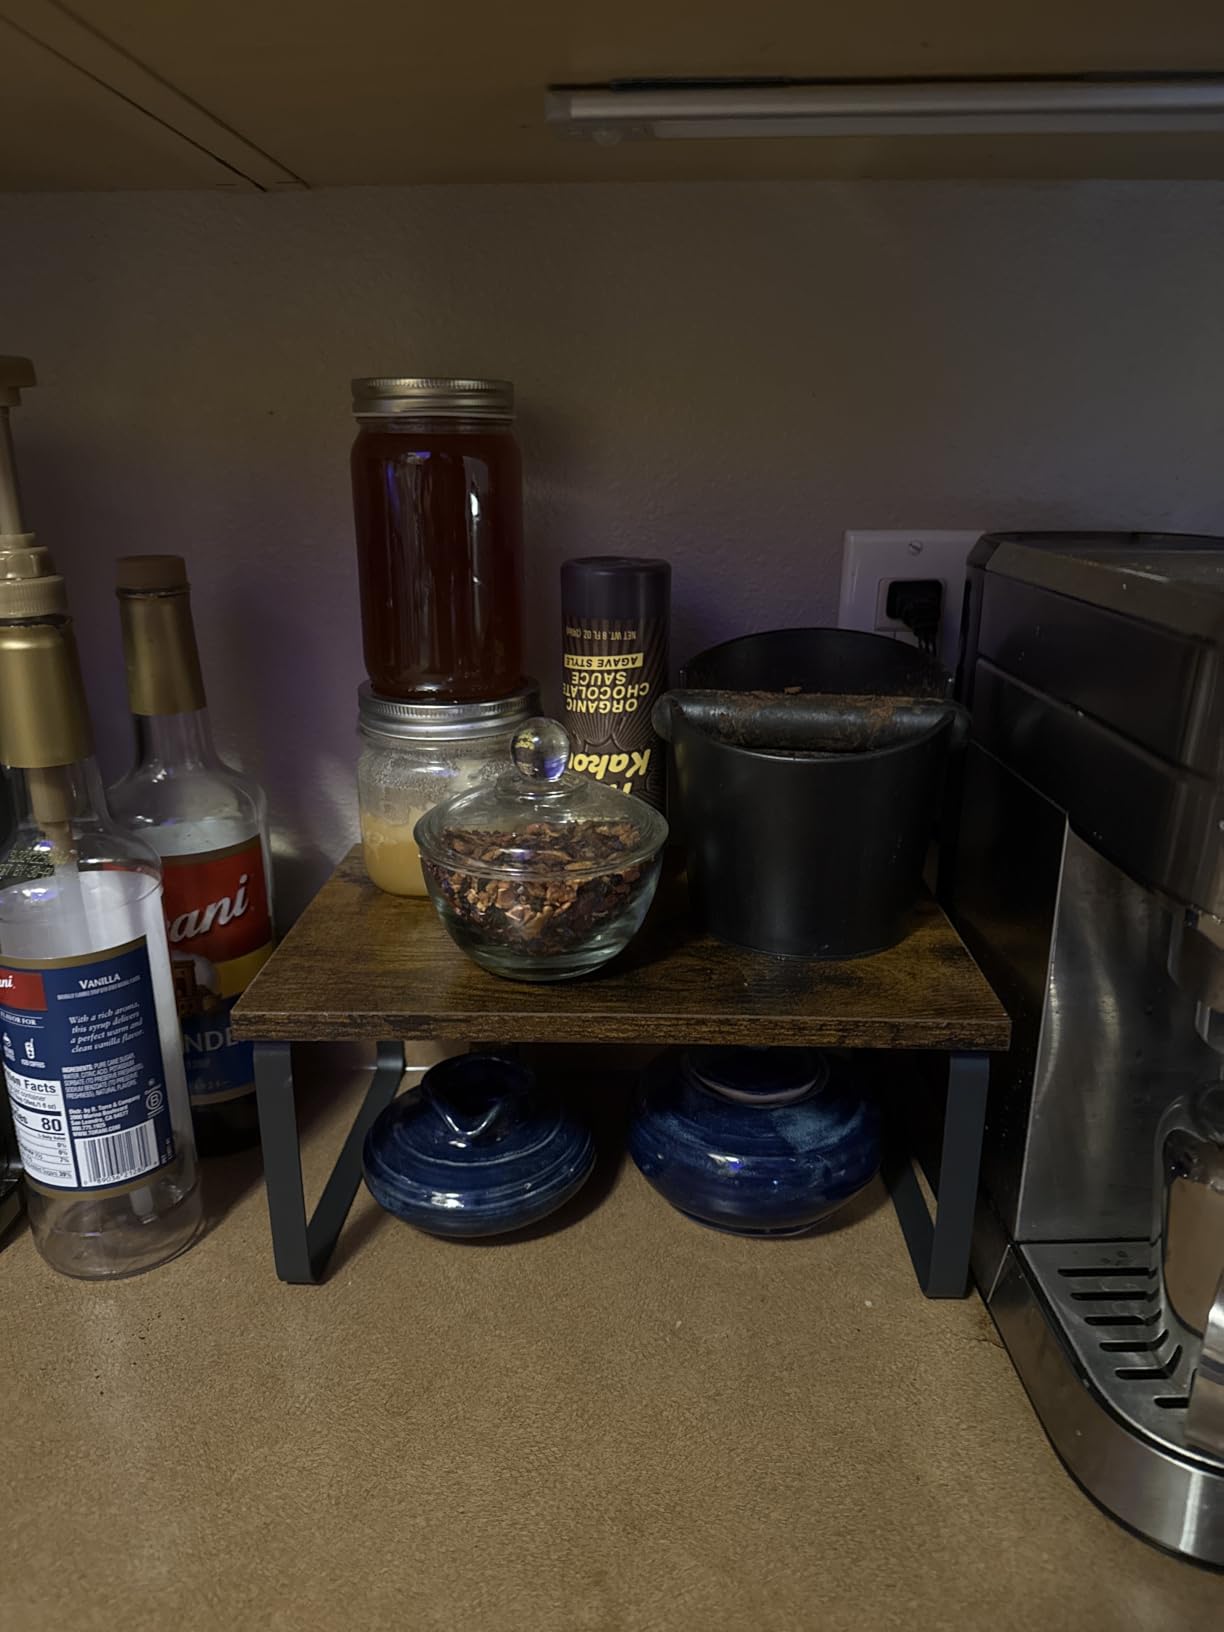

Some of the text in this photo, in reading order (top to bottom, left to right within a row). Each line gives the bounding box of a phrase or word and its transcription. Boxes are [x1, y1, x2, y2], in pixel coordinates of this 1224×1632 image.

[566, 656, 638, 668] AGAVE STYLE
[571, 671, 627, 686] SAUCE
[562, 682, 650, 699] CHOCOLATE
[566, 698, 638, 714] ORGANIC
[78, 972, 121, 990] VANILLA
[68, 1014, 89, 1025] With
[97, 1008, 113, 1019] rich
[71, 1025, 87, 1034] this
[88, 1020, 112, 1032] syrup
[77, 1031, 105, 1044] perfect
[106, 1025, 129, 1037] warm
[71, 1044, 93, 1054] clean
[94, 1037, 121, 1050] vanilla
[23, 1078, 56, 1094] Facts
[40, 1117, 62, 1132] 80
